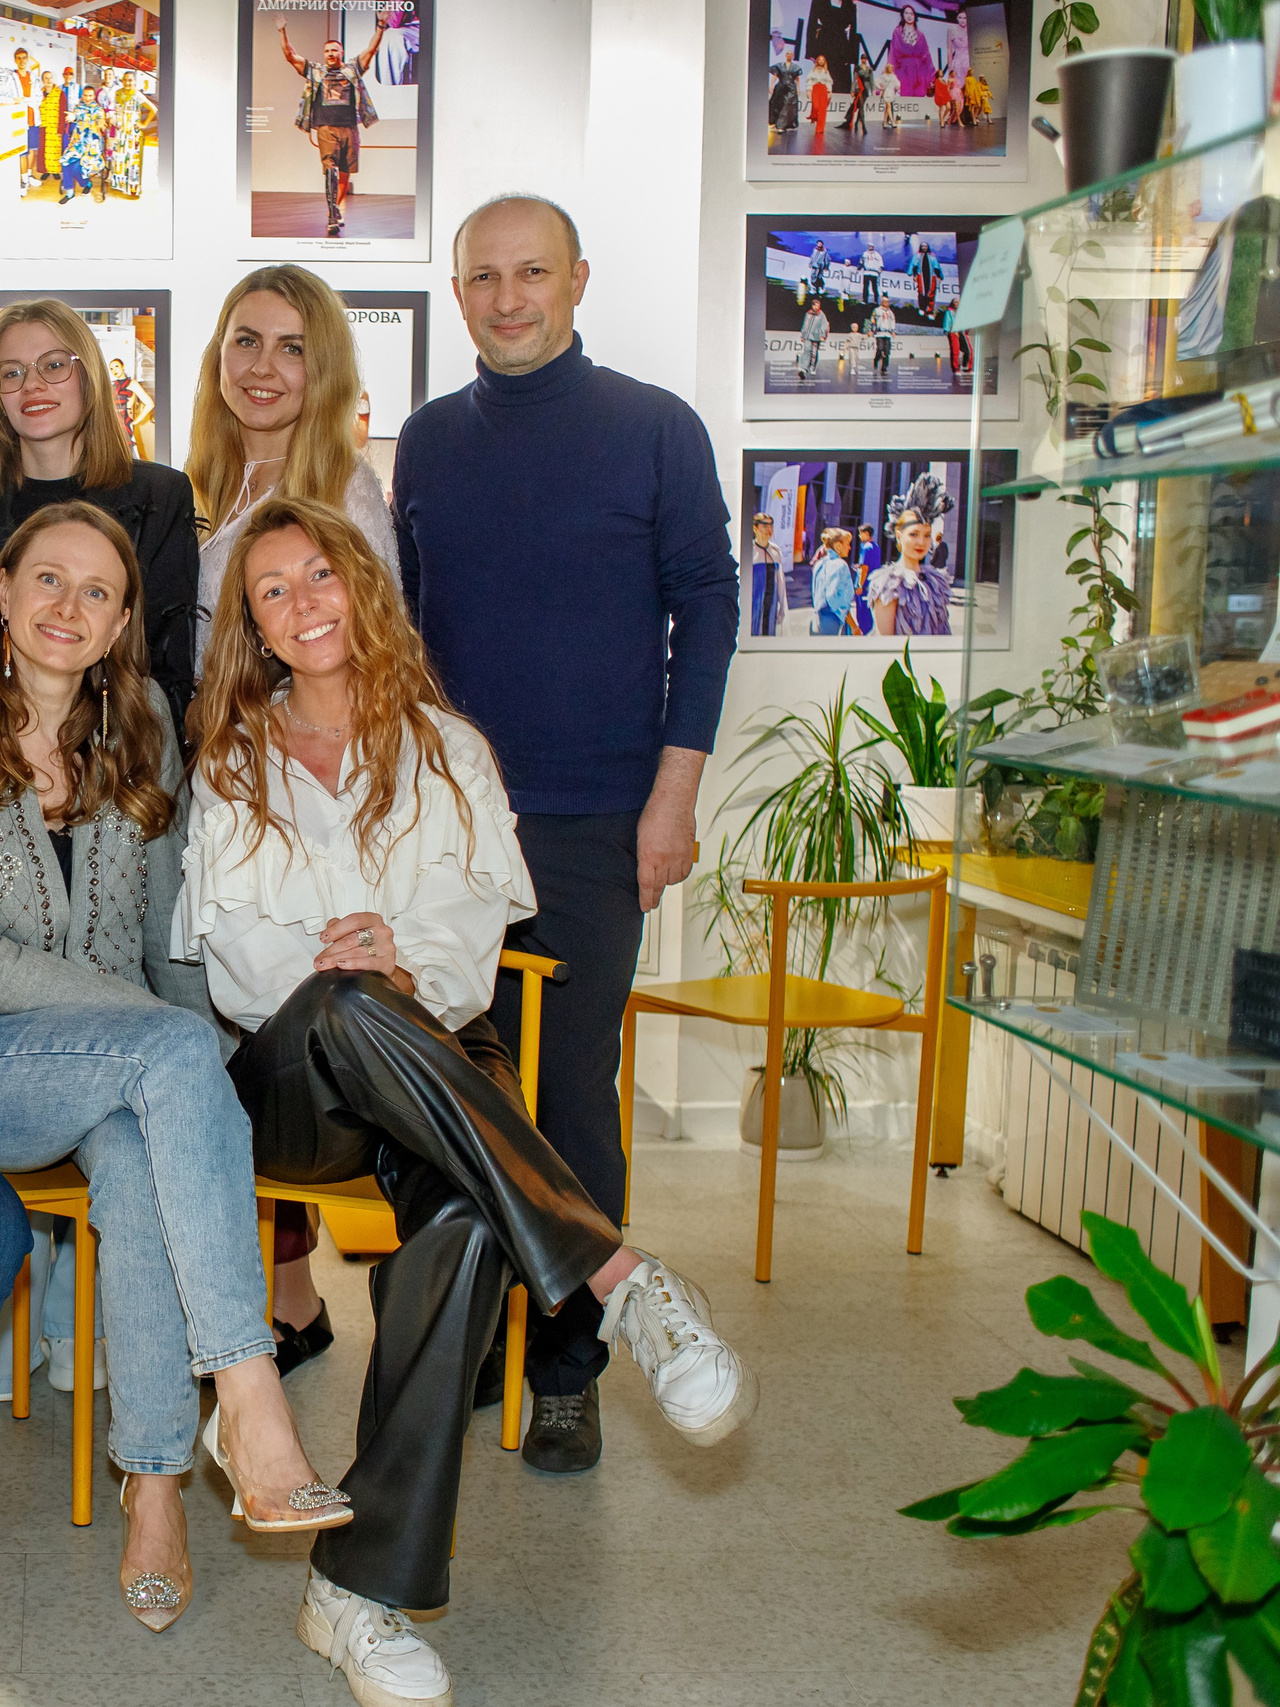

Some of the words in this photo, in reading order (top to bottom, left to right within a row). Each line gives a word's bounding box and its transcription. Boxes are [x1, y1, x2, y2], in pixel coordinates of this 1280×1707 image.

[329, 0, 415, 12] СКУПЧЕНКО
[797, 101, 846, 112] ОЛШЕ
[878, 102, 920, 112] БЗНЕС
[904, 279, 961, 295] БИЕС
[766, 339, 826, 352] БОЛЬЕ
[829, 340, 846, 351] ЧЕ
[859, 341, 903, 352] БИЕС
